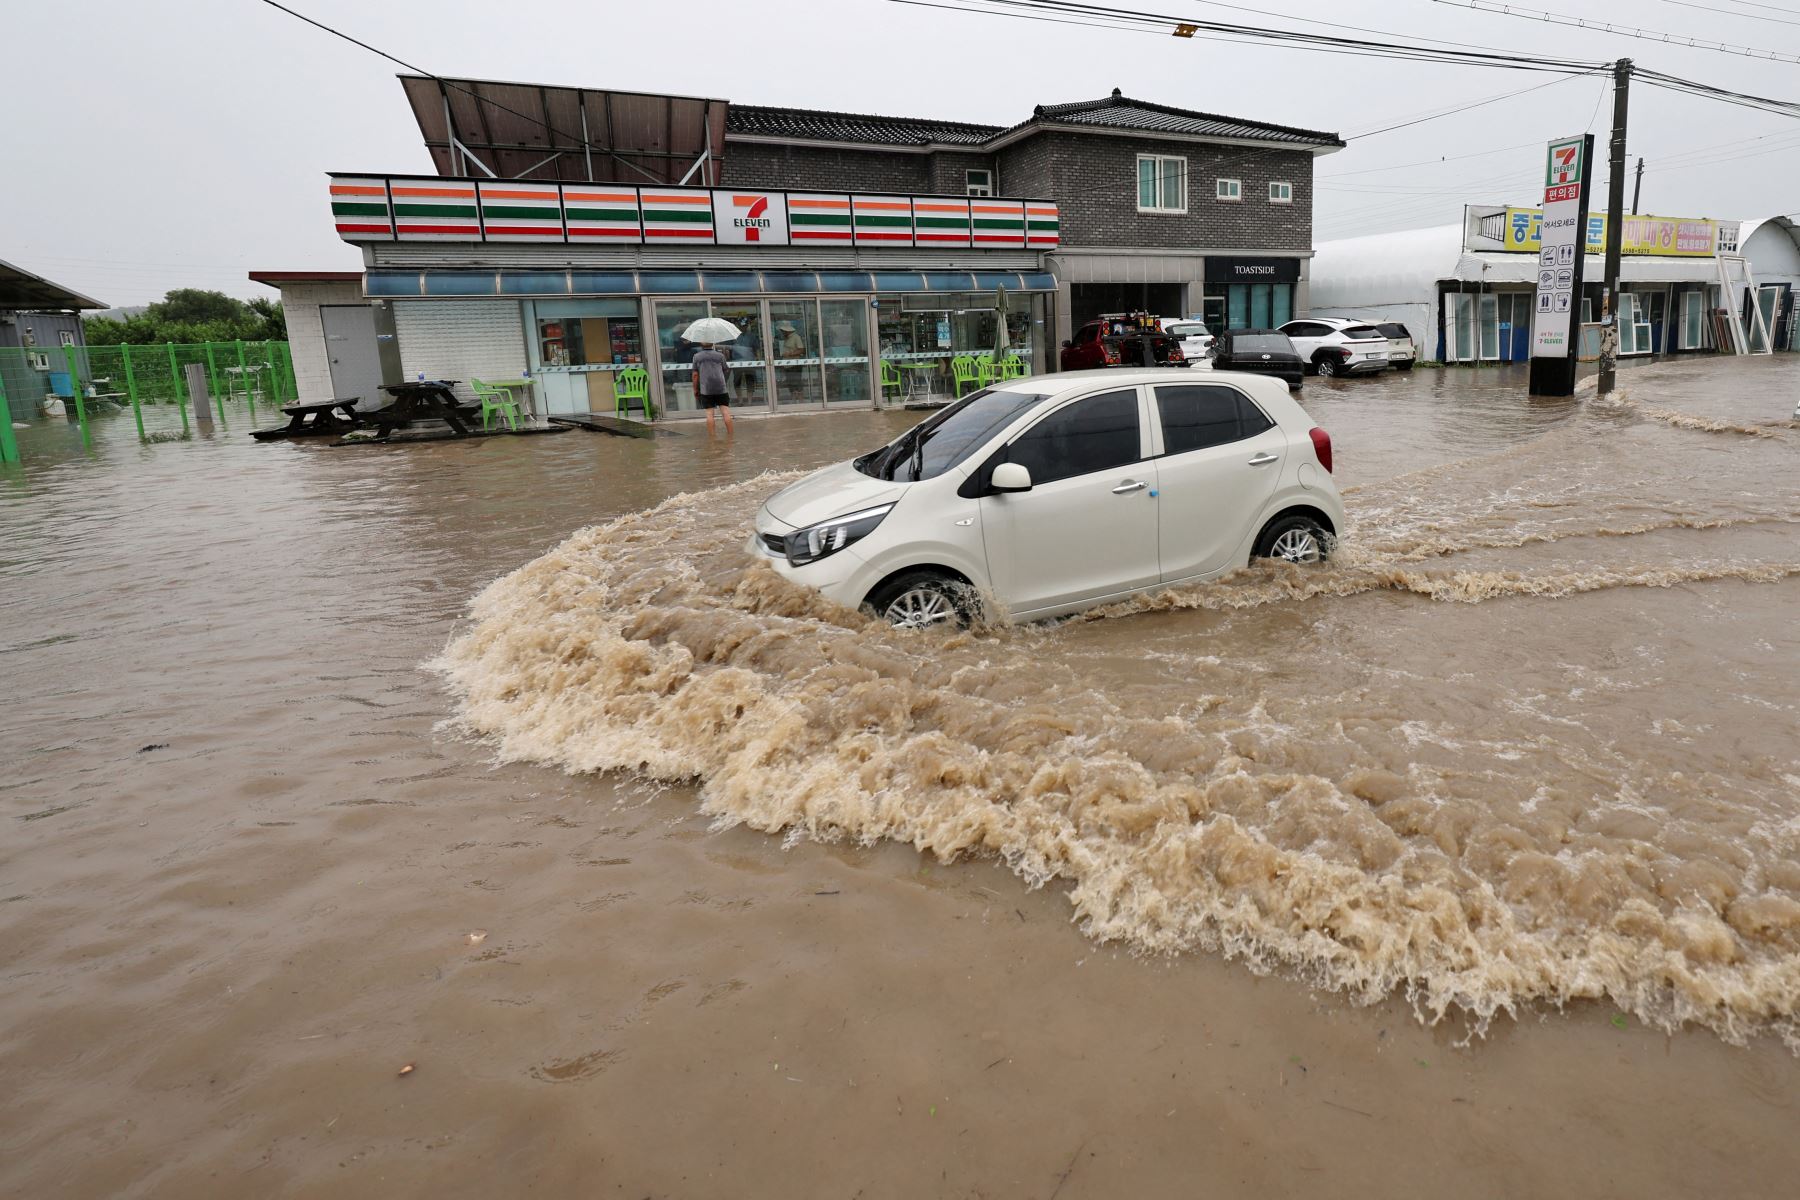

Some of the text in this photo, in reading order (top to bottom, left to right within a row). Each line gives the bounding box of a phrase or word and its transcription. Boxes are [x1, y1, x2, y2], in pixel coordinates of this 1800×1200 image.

[1556, 147, 1576, 183] 7
[1549, 186, 1576, 200] 편의점
[732, 196, 768, 241] 7
[1544, 218, 1576, 229] 어서오세요
[1234, 265, 1276, 275] TOASTSIDE
